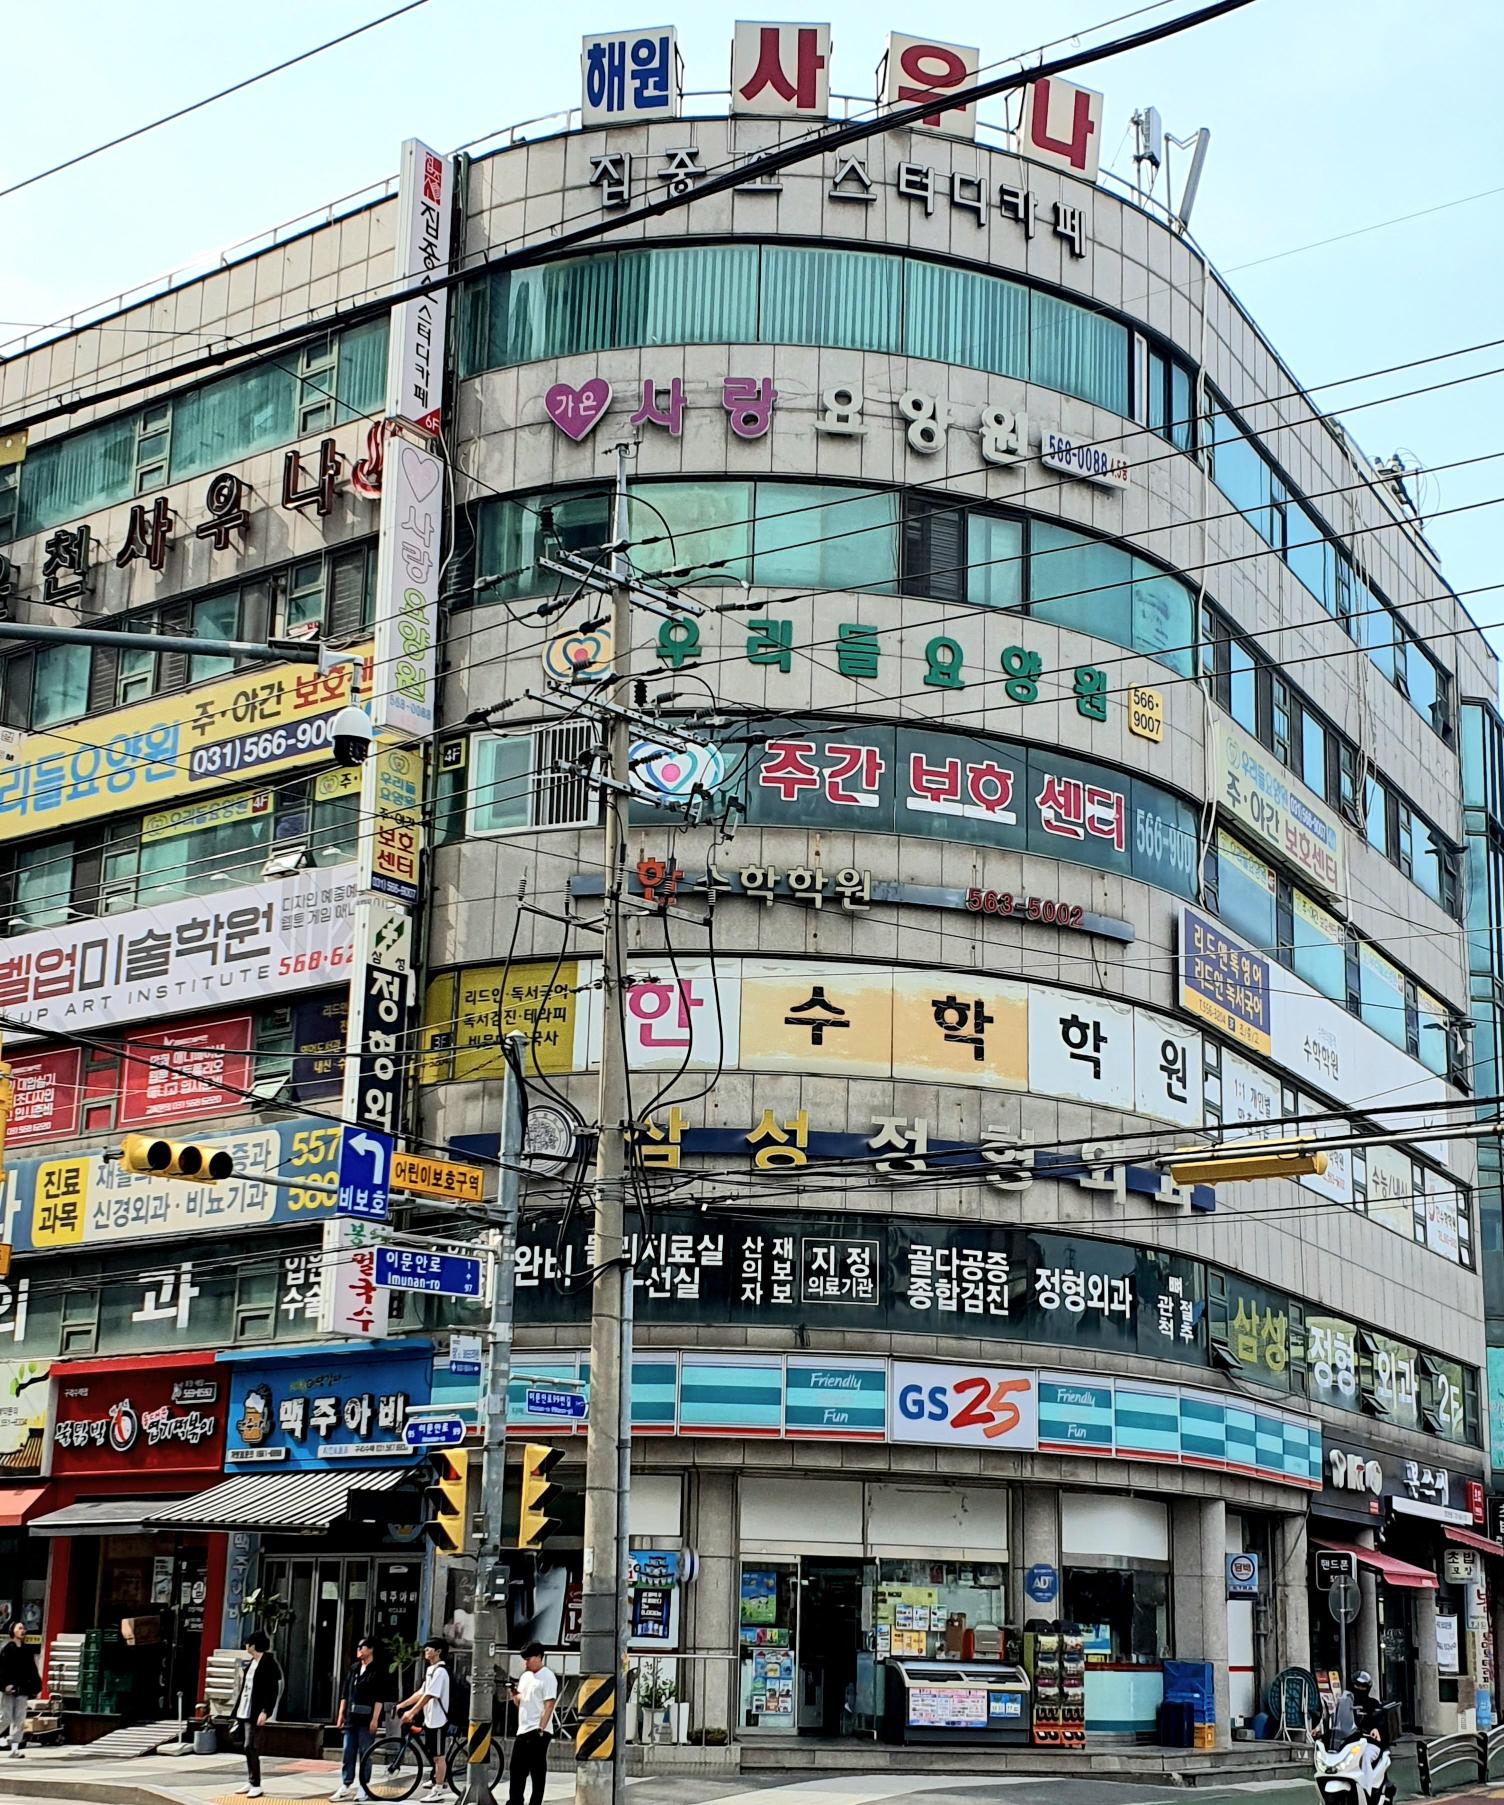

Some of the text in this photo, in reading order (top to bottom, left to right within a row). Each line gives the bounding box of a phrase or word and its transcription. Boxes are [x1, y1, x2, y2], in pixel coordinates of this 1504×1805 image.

[586, 27, 1096, 171] 해원 사우나
[828, 155, 1087, 259] 스터디카페
[412, 304, 432, 410] 스터디카페
[425, 411, 440, 431] 6F
[629, 376, 778, 439] 사랑
[1048, 433, 1108, 474] 568-0088
[656, 618, 1108, 722] 우리들요양원
[191, 679, 286, 737] 주·야간
[1132, 710, 1162, 736] 9007
[444, 747, 461, 762] 4F
[760, 740, 1127, 852] 주간 보호 센터
[378, 825, 415, 855] 보호
[1226, 769, 1281, 844] 주·야간
[1285, 819, 1338, 892] 보호센터
[377, 849, 414, 879] 센터
[282, 890, 319, 913] 디자인
[965, 886, 1084, 928] 563-5002
[65, 995, 113, 1017] ART
[128, 964, 272, 1003] INSTITUTE
[291, 1126, 342, 1168] 557
[43, 1167, 81, 1200] 진료
[394, 1160, 480, 1195] 어린이보호구역
[339, 1184, 387, 1216] 비보호
[37, 1202, 79, 1235] 과목
[385, 1250, 442, 1275] 이문안로
[513, 1244, 573, 1287] 완비
[811, 1242, 872, 1274] 지정
[906, 1243, 1011, 1284] 골다공증
[387, 1272, 441, 1291] Imunan-ro
[806, 1274, 874, 1300] 의료기관
[905, 1275, 1011, 1317] 종합검진
[1034, 1266, 1133, 1320] 정형외과
[1233, 1296, 1288, 1373] 삼성
[1307, 1324, 1420, 1416] 정형외과
[809, 1371, 862, 1393] Friendly
[1056, 1387, 1097, 1410] Friendly
[279, 1392, 405, 1440] 맥주아비
[821, 1407, 850, 1425] Fun
[898, 1376, 1032, 1440] GS25
[417, 1422, 450, 1435] 이문안로
[1066, 1422, 1087, 1440] Fun
[1319, 1558, 1350, 1571] 핸드폰
[1032, 1576, 1055, 1589] ADT
